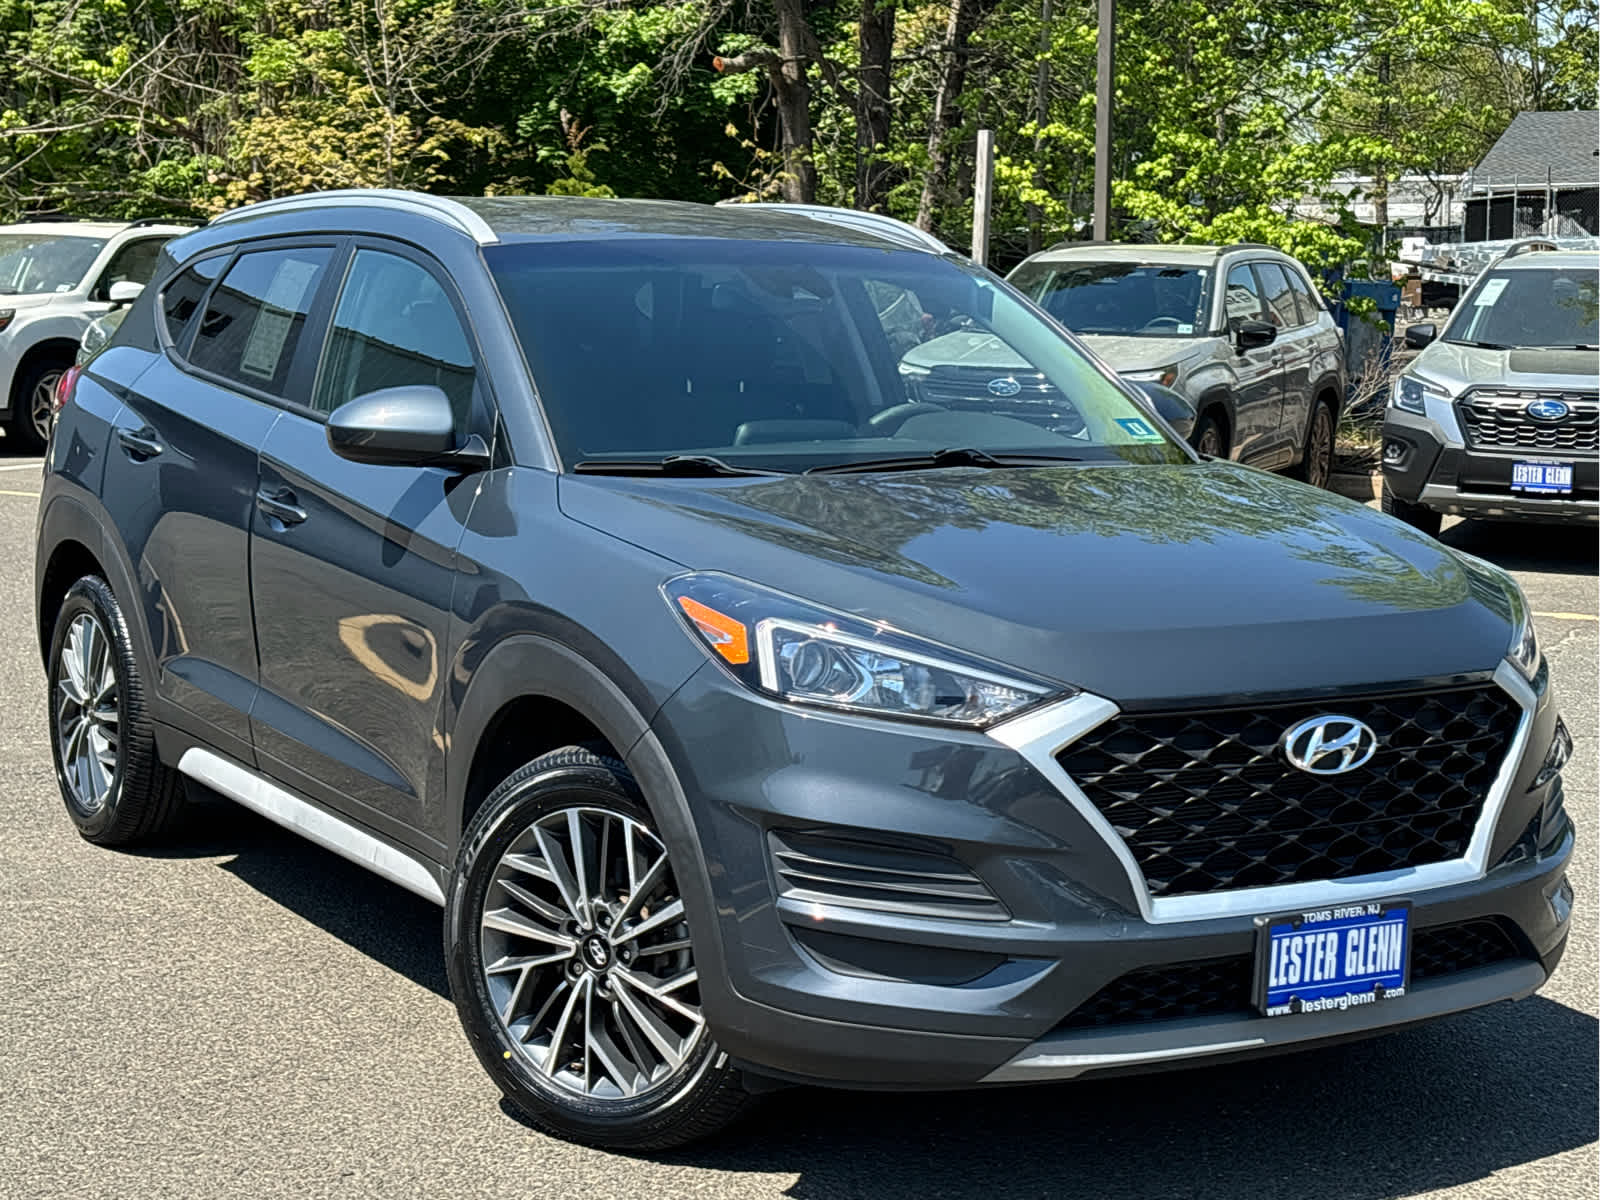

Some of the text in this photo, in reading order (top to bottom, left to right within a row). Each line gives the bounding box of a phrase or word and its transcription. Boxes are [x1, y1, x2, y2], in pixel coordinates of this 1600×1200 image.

[1513, 465, 1542, 483] LESTER
[1303, 909, 1332, 923] TOMS
[1367, 903, 1381, 915] NJ
[1269, 923, 1404, 988] LESTER GLENN
